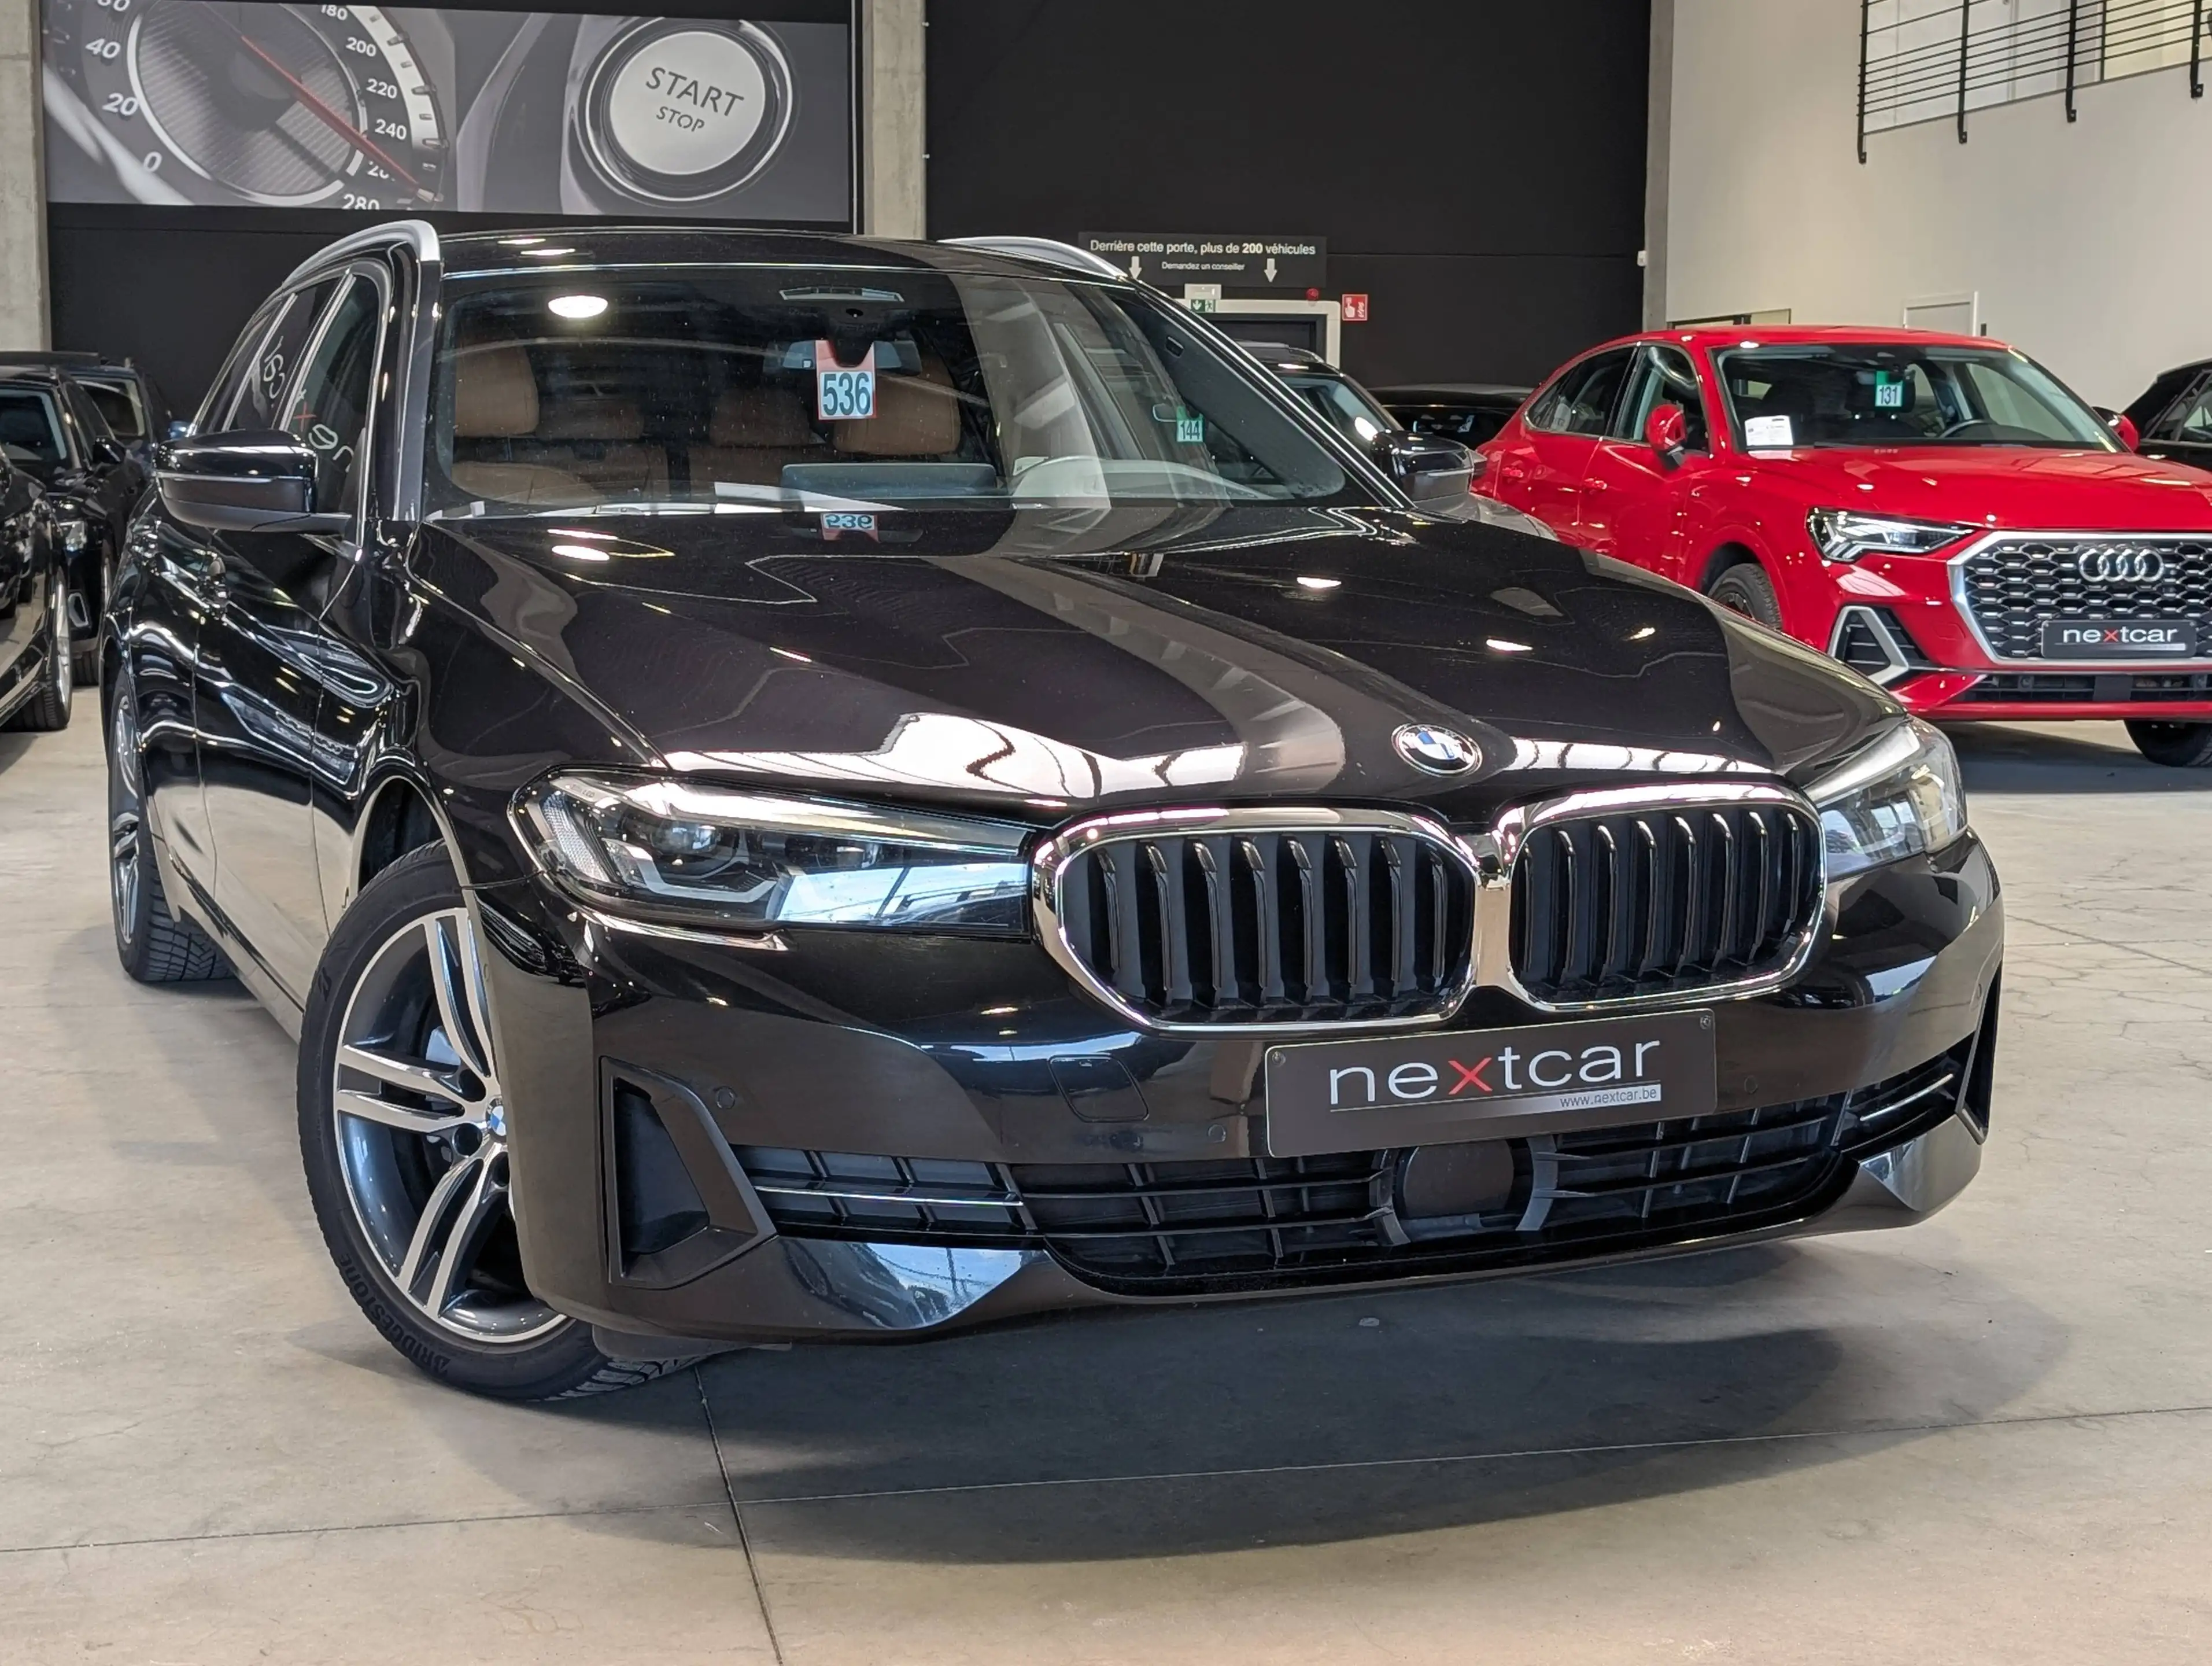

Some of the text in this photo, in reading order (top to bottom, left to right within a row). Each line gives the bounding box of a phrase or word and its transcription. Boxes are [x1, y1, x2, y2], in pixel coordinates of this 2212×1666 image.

[85, 38, 121, 58] 40
[346, 37, 376, 57] 200
[366, 78, 397, 99] 220
[646, 67, 744, 116] START
[102, 93, 138, 116] 20
[656, 106, 705, 132] STOP
[374, 119, 407, 140] 240
[144, 151, 163, 172] 0
[342, 193, 380, 210] 280
[1090, 239, 1316, 255] Derrière cette porte, plus de 200 véhicules
[1161, 261, 1200, 270] Demandez
[822, 372, 871, 416] 536
[1879, 386, 1897, 405] 131
[1180, 421, 1200, 440] 144
[2063, 626, 2178, 643] nextcar
[1330, 1040, 1660, 1104] nextcar
[1560, 1088, 1657, 1107] www.nextcar.be
